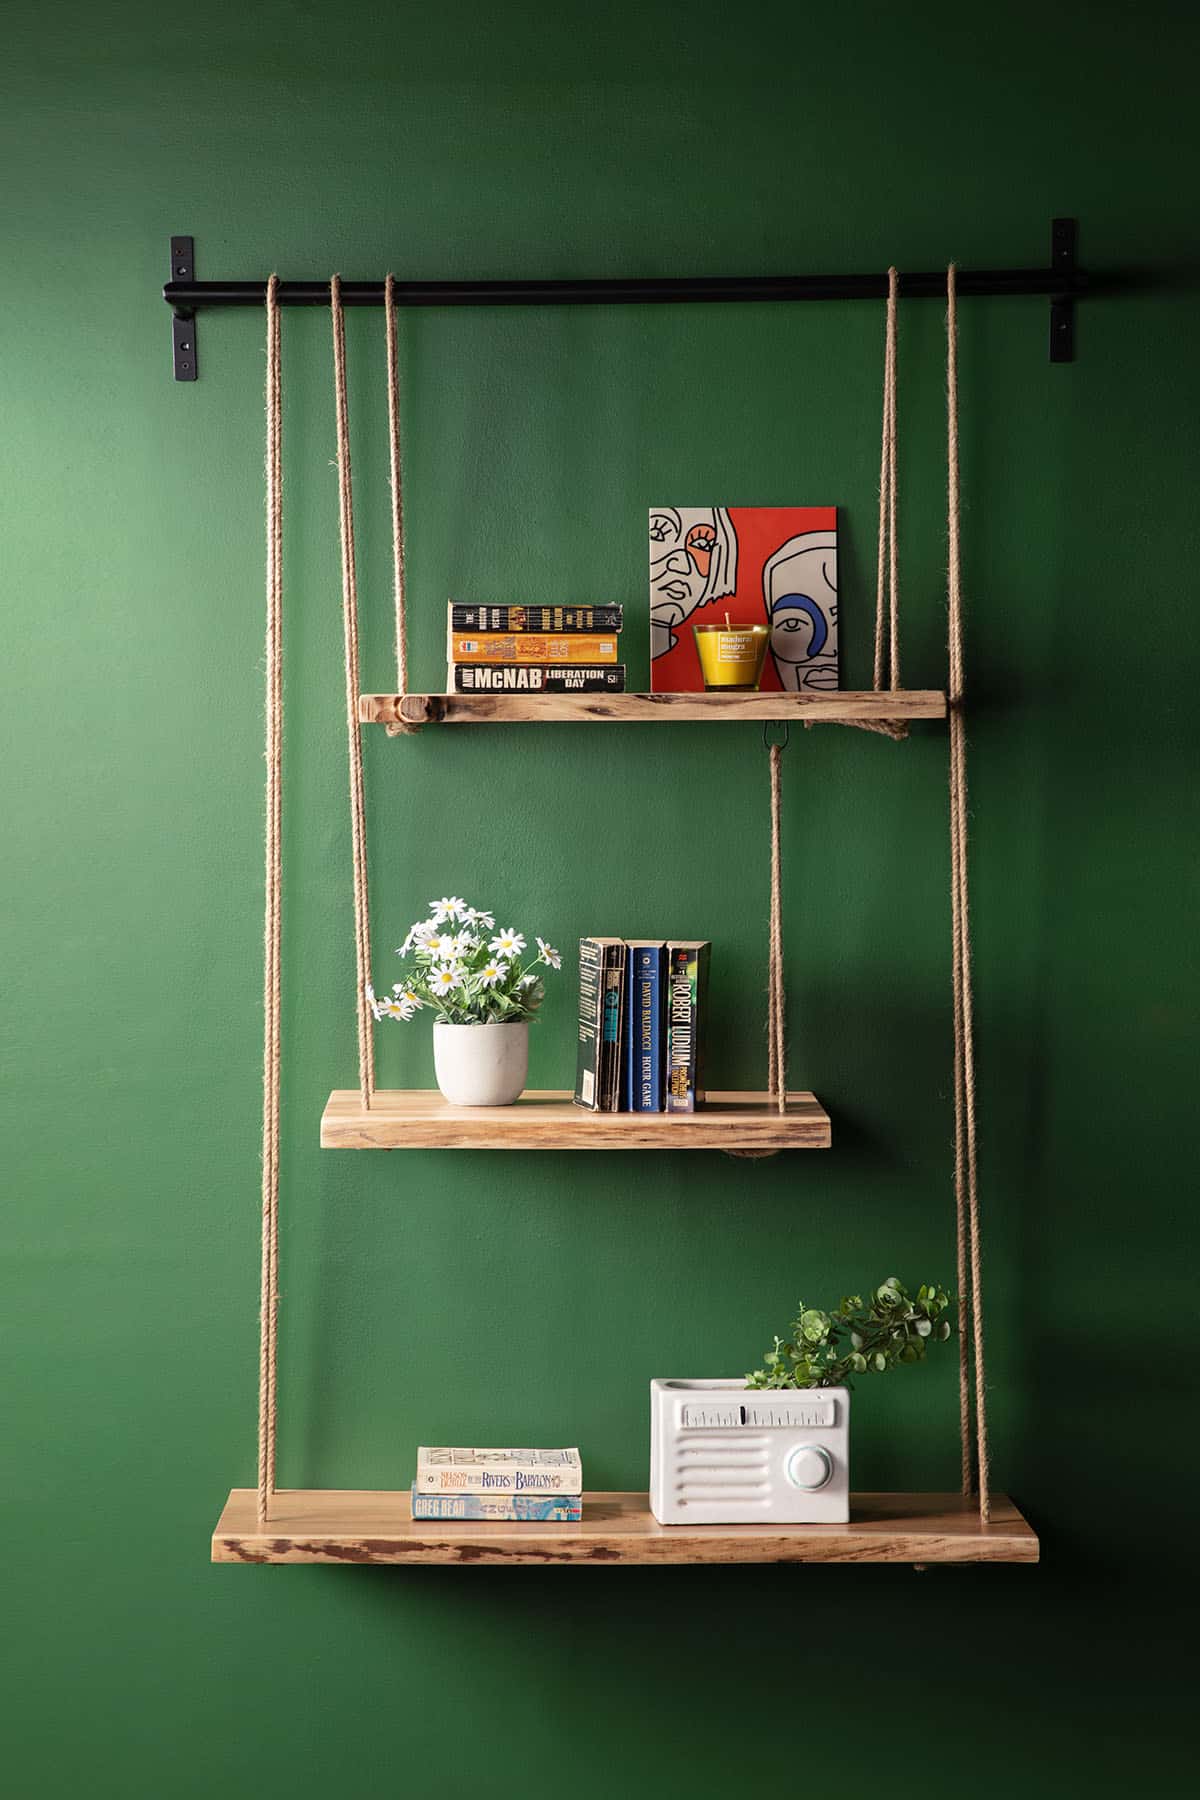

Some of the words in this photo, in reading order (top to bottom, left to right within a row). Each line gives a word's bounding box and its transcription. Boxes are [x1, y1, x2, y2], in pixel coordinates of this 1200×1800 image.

[462, 668, 474, 688] ANDY
[474, 668, 543, 689] McNAB
[546, 670, 604, 679] LIBERATION
[565, 679, 586, 688] DAY
[641, 982, 652, 1008] DAVID
[672, 983, 691, 1023] ROBERT
[641, 1009, 652, 1051] BALDACCI
[672, 1025, 691, 1066] LUDLUM
[641, 1056, 652, 1081] HOUR
[641, 1083, 652, 1107] GAME
[482, 1472, 512, 1489] RIVERS
[515, 1471, 551, 1490] BABYLON
